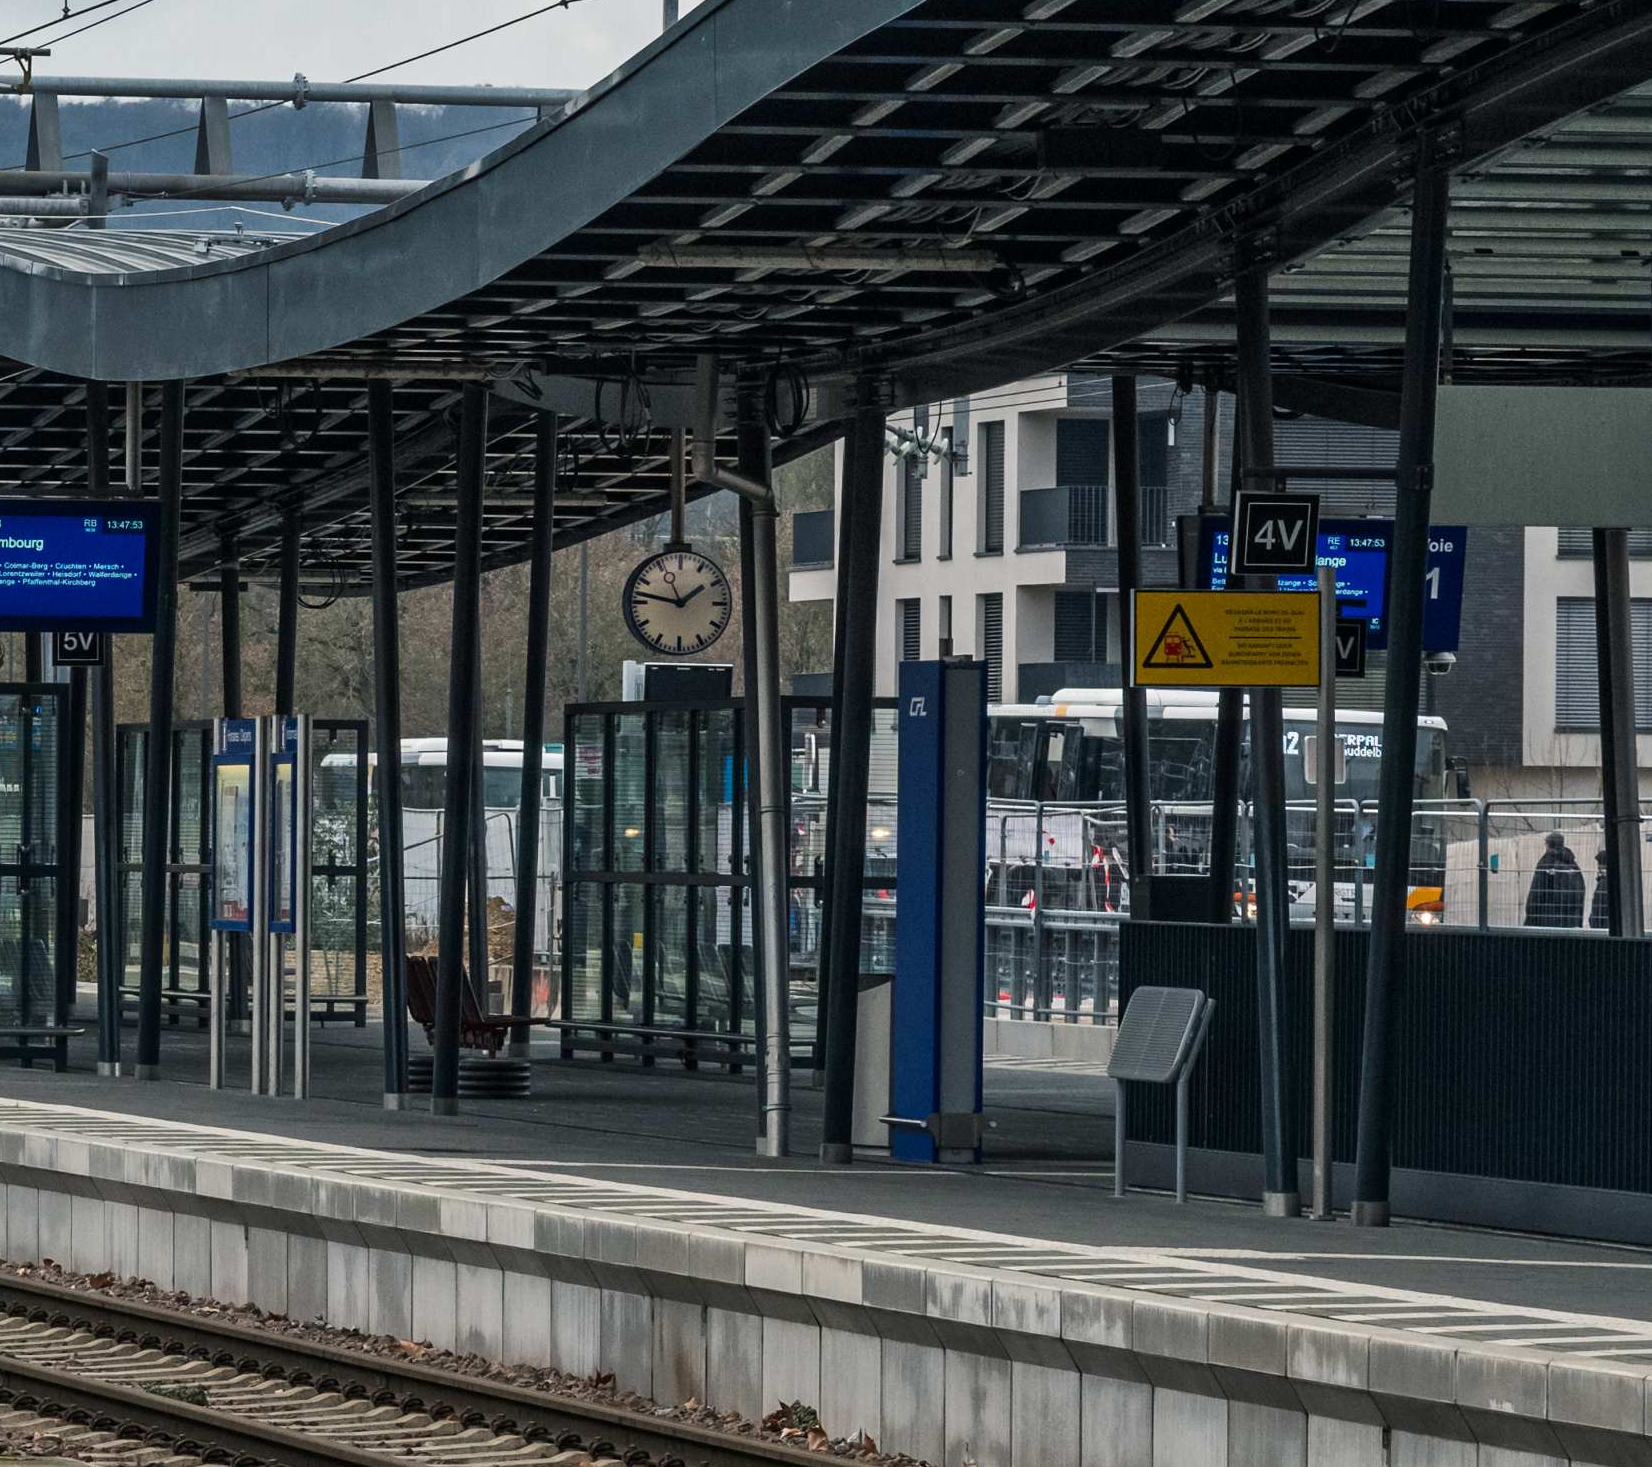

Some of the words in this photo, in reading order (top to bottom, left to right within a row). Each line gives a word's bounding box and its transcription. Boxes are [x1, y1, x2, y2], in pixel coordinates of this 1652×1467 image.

[84, 518, 97, 528] RB
[106, 520, 144, 530] 13:47:53
[1254, 519, 1304, 551] 4V
[1327, 536, 1340, 545] RE
[1349, 538, 1386, 547] 13:47:53
[1427, 538, 1454, 553] oie
[1425, 566, 1441, 600] 1
[64, 632, 94, 651] 5V
[1336, 635, 1355, 659] V
